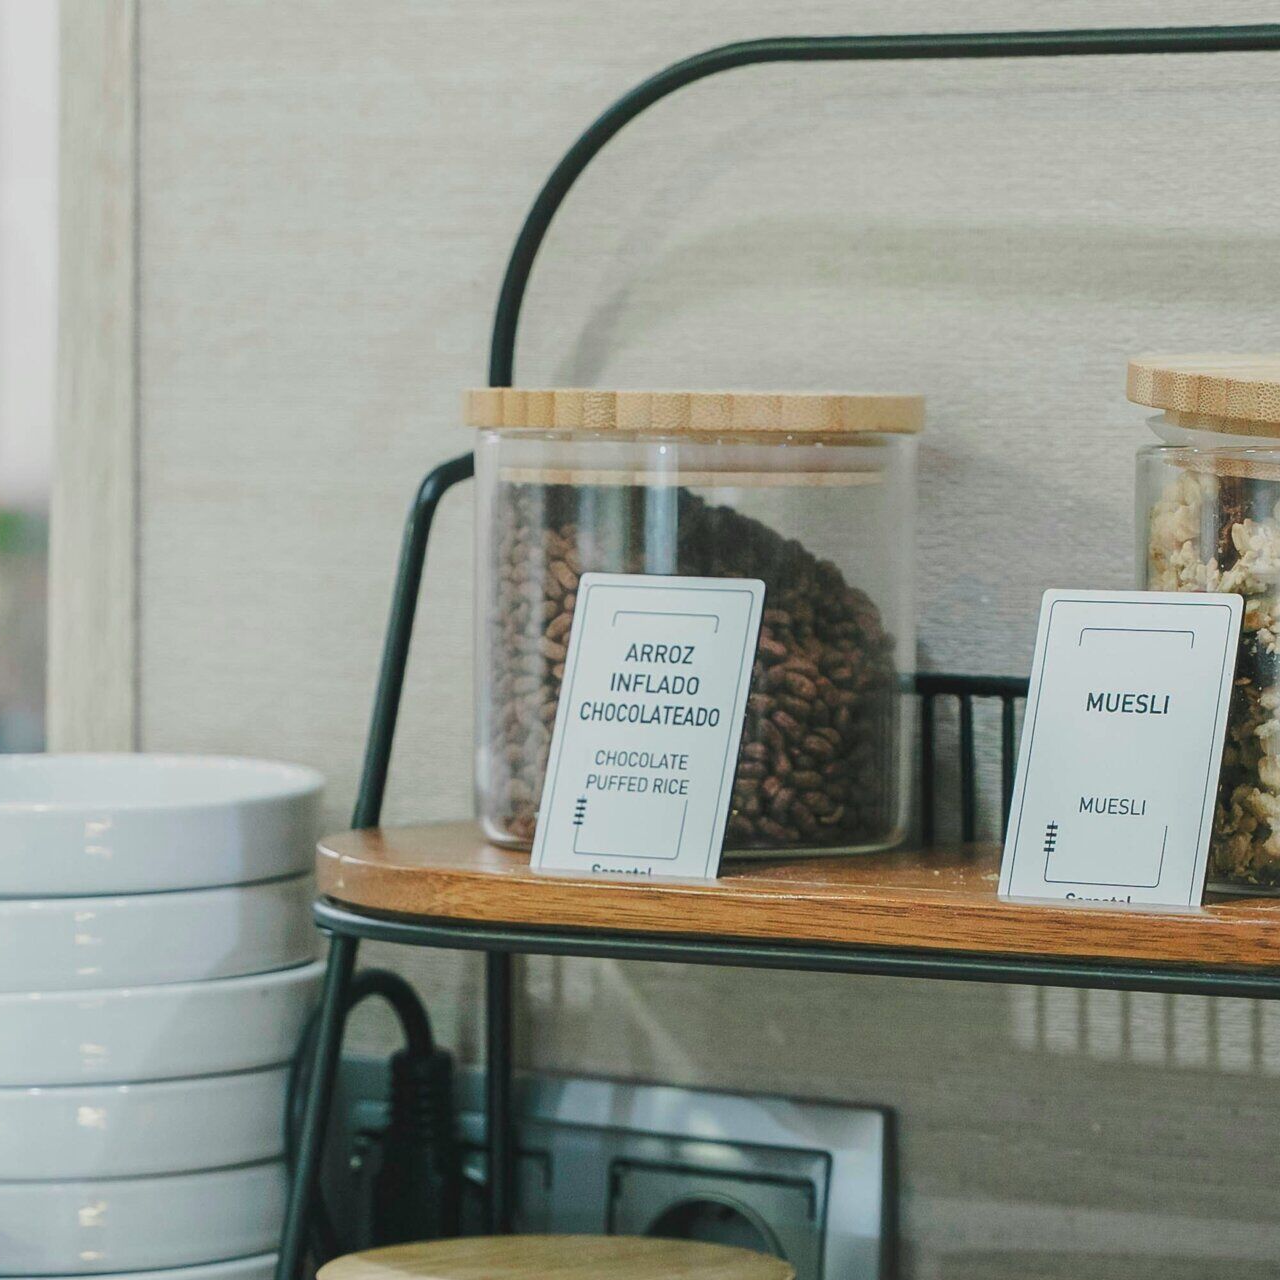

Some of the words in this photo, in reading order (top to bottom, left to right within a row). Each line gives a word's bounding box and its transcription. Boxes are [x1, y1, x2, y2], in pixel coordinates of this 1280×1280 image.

[624, 643, 696, 665] ARROZ
[610, 672, 700, 696] INFLADO
[579, 701, 721, 728] CHOCOLATEADO
[1086, 692, 1170, 715] MUESLI
[594, 749, 690, 771] CHOCOLATE
[585, 773, 649, 793] PUFFED
[652, 777, 690, 796] RICE
[1079, 796, 1146, 816] MUESLI
